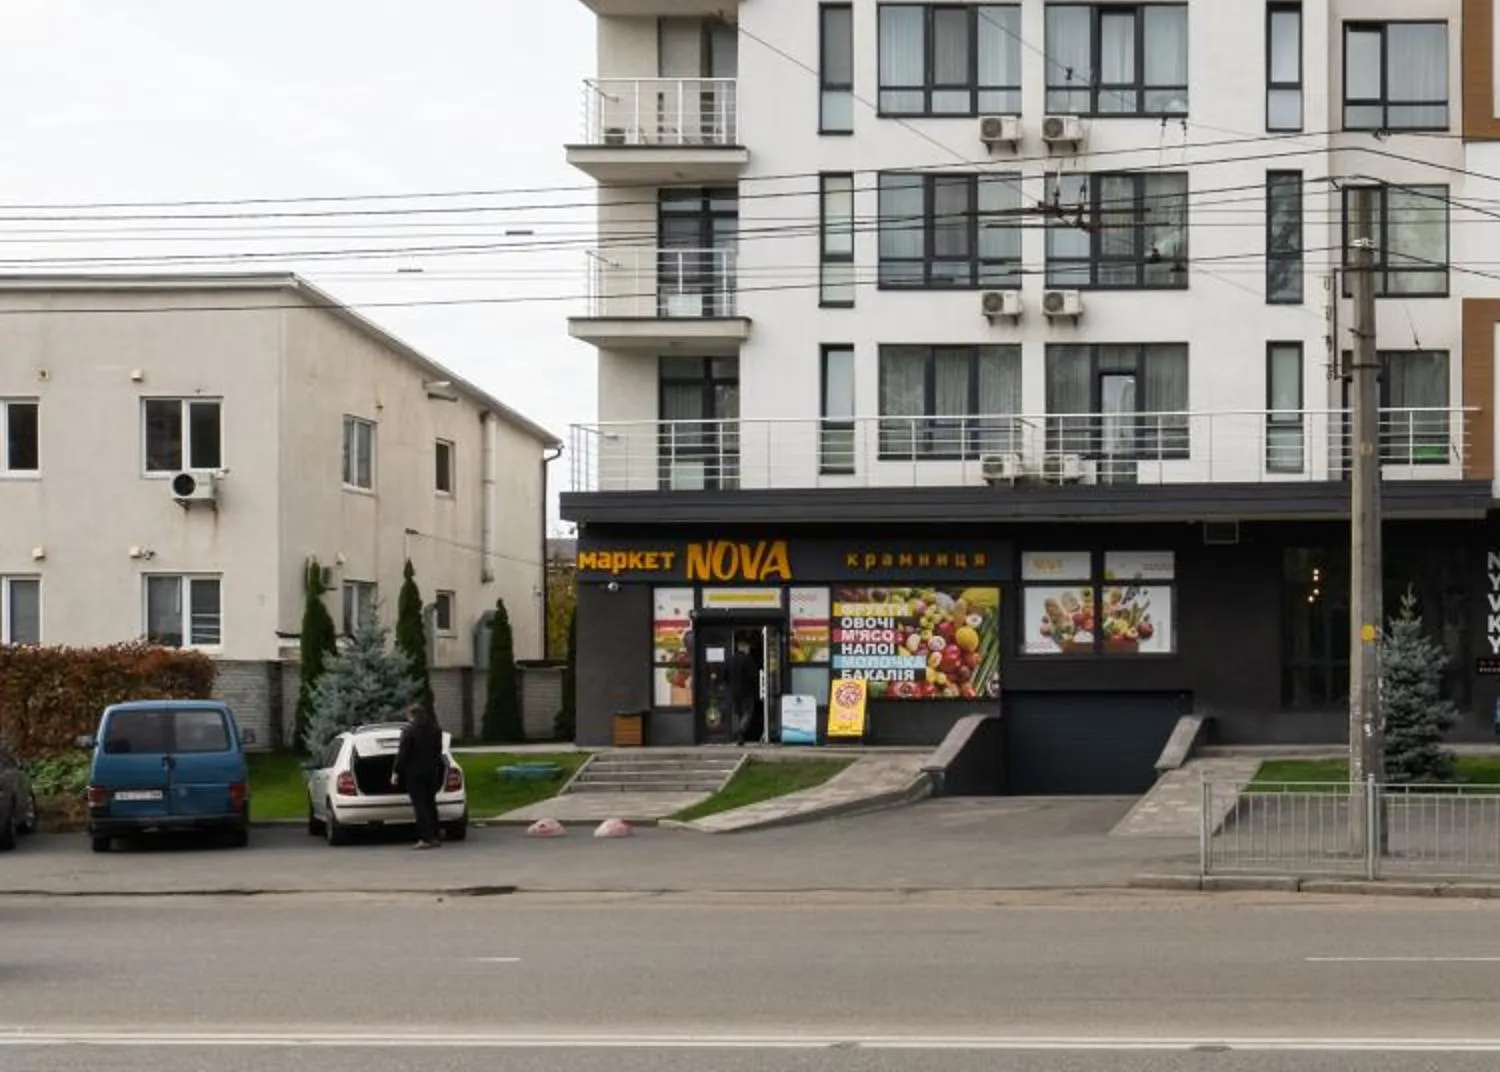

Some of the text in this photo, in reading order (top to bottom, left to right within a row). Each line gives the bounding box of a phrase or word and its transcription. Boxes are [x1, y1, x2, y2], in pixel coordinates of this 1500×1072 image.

[686, 540, 793, 581] NOVA
[841, 617, 895, 629] ОВОЧІ
[841, 629, 895, 642] М'ЯСО
